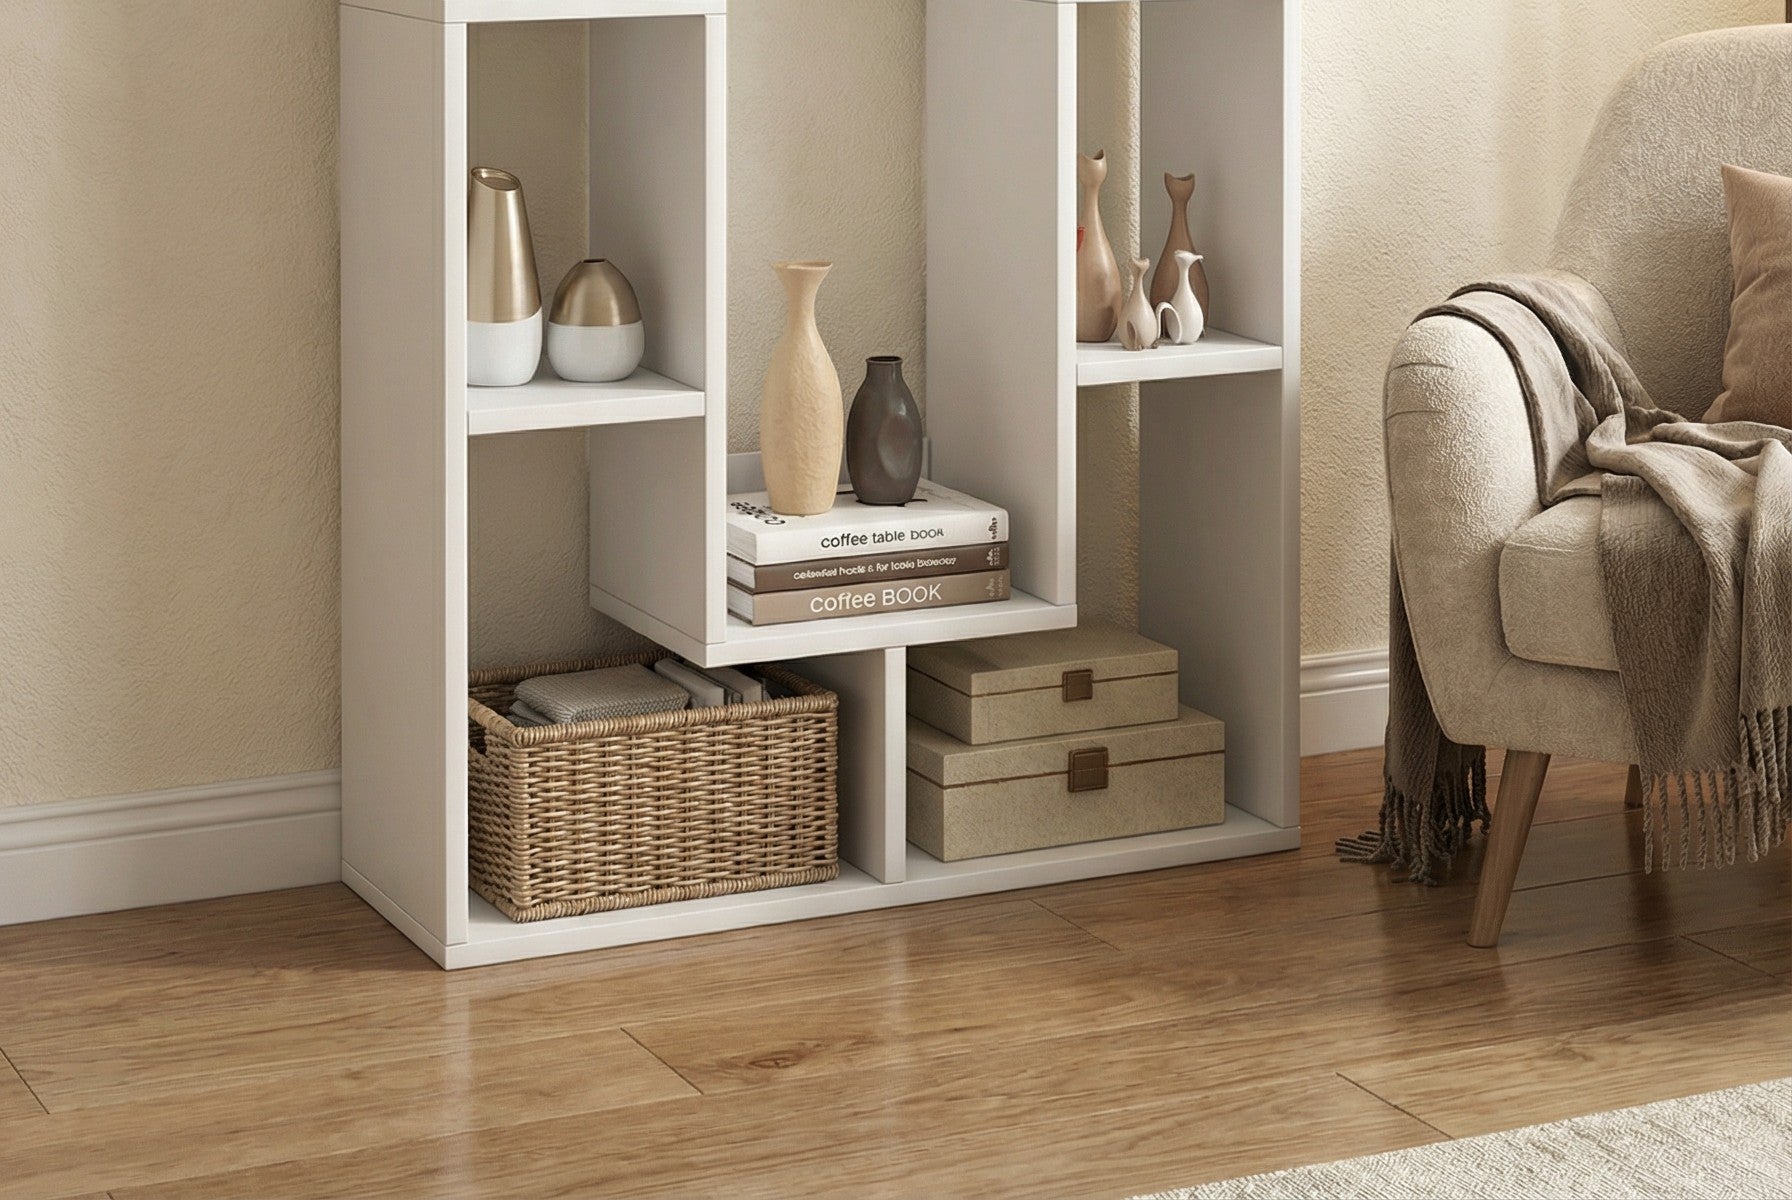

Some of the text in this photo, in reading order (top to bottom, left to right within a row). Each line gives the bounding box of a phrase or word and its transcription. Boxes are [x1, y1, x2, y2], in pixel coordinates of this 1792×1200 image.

[820, 532, 869, 549] coffee
[872, 530, 906, 544] table
[881, 583, 943, 607] BOOK
